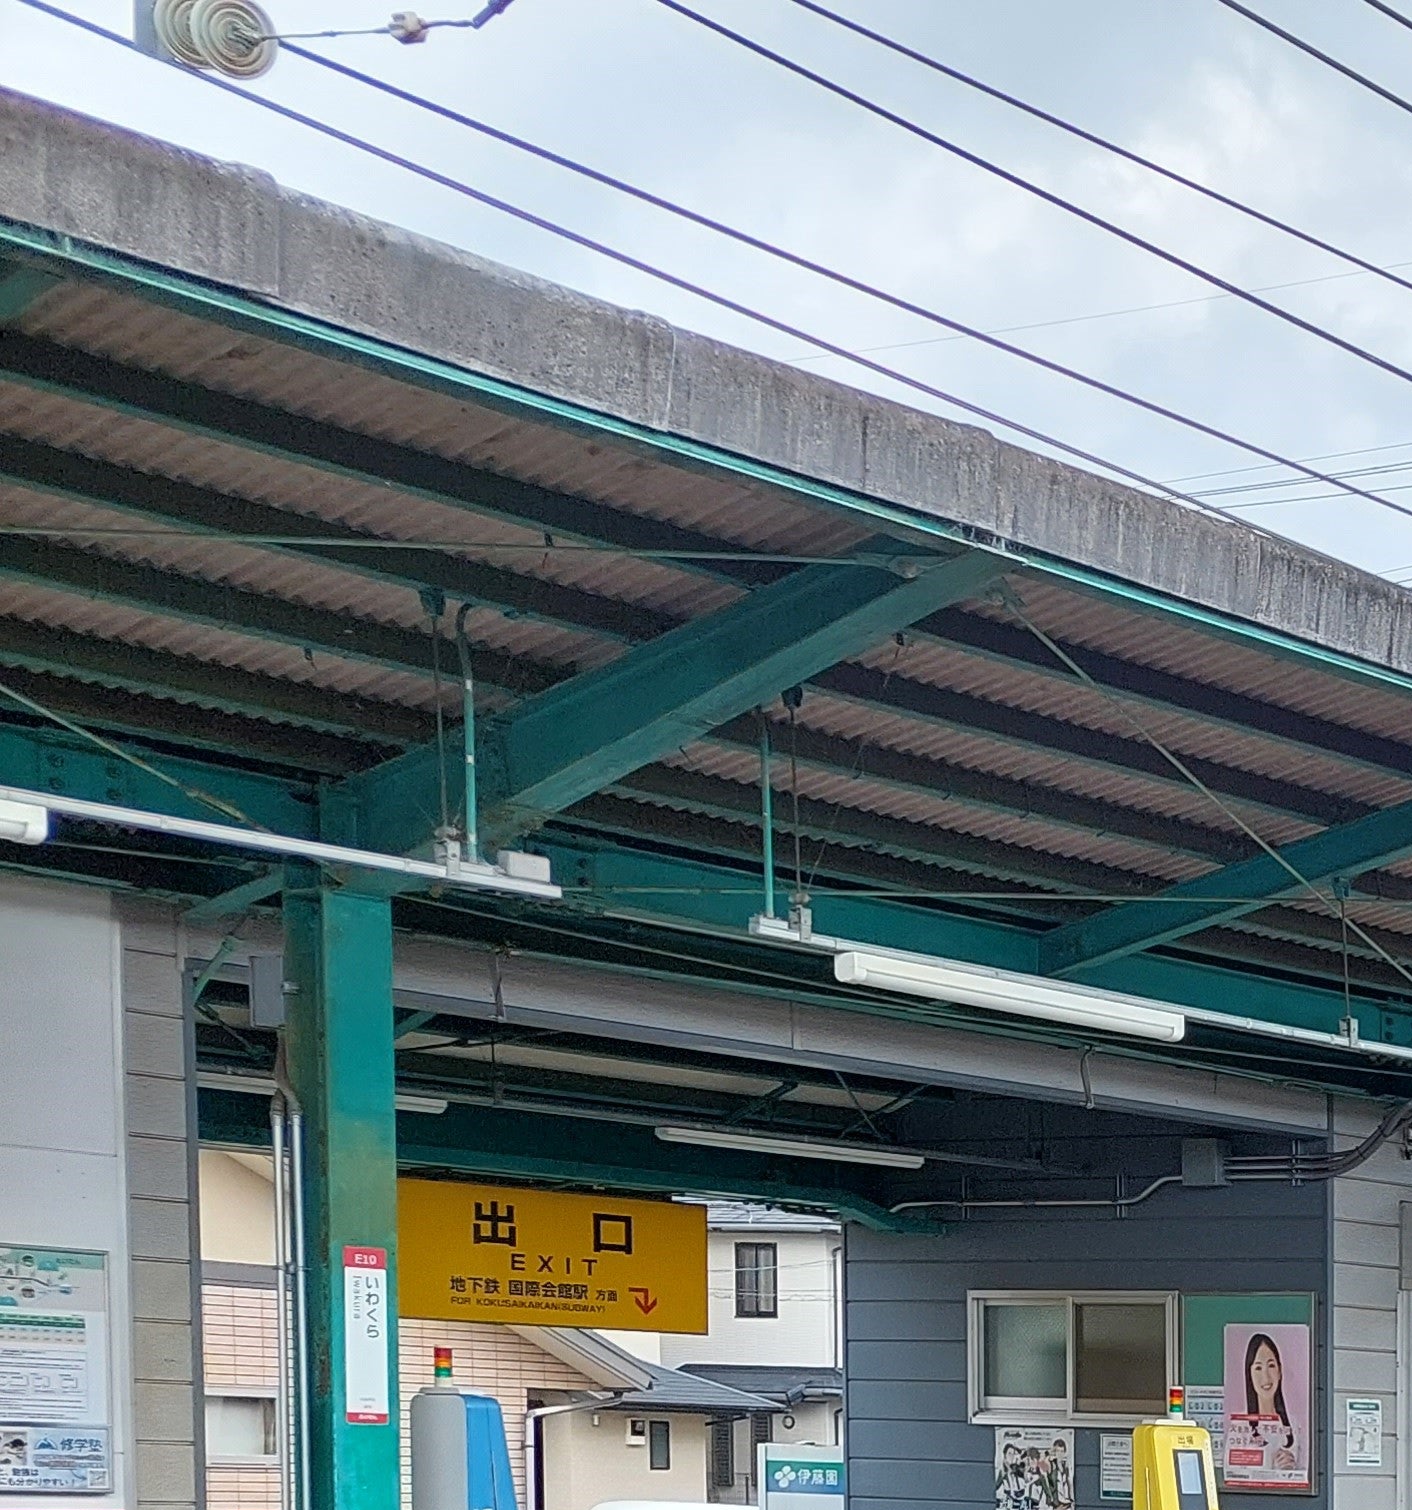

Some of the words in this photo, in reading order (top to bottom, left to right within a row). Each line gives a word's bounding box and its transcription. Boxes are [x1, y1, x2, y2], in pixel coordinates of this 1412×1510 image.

[354, 1253, 378, 1265] E10
[510, 1252, 599, 1277] EXIT
[352, 1275, 363, 1320] Iwakura
[449, 1275, 501, 1295] 地下鉄
[508, 1279, 589, 1301] 国際会館駅
[595, 1289, 619, 1303] 方面
[450, 1296, 471, 1306] FOR
[365, 1275, 381, 1339] いわくら
[797, 1468, 839, 1487] 伊藤園
